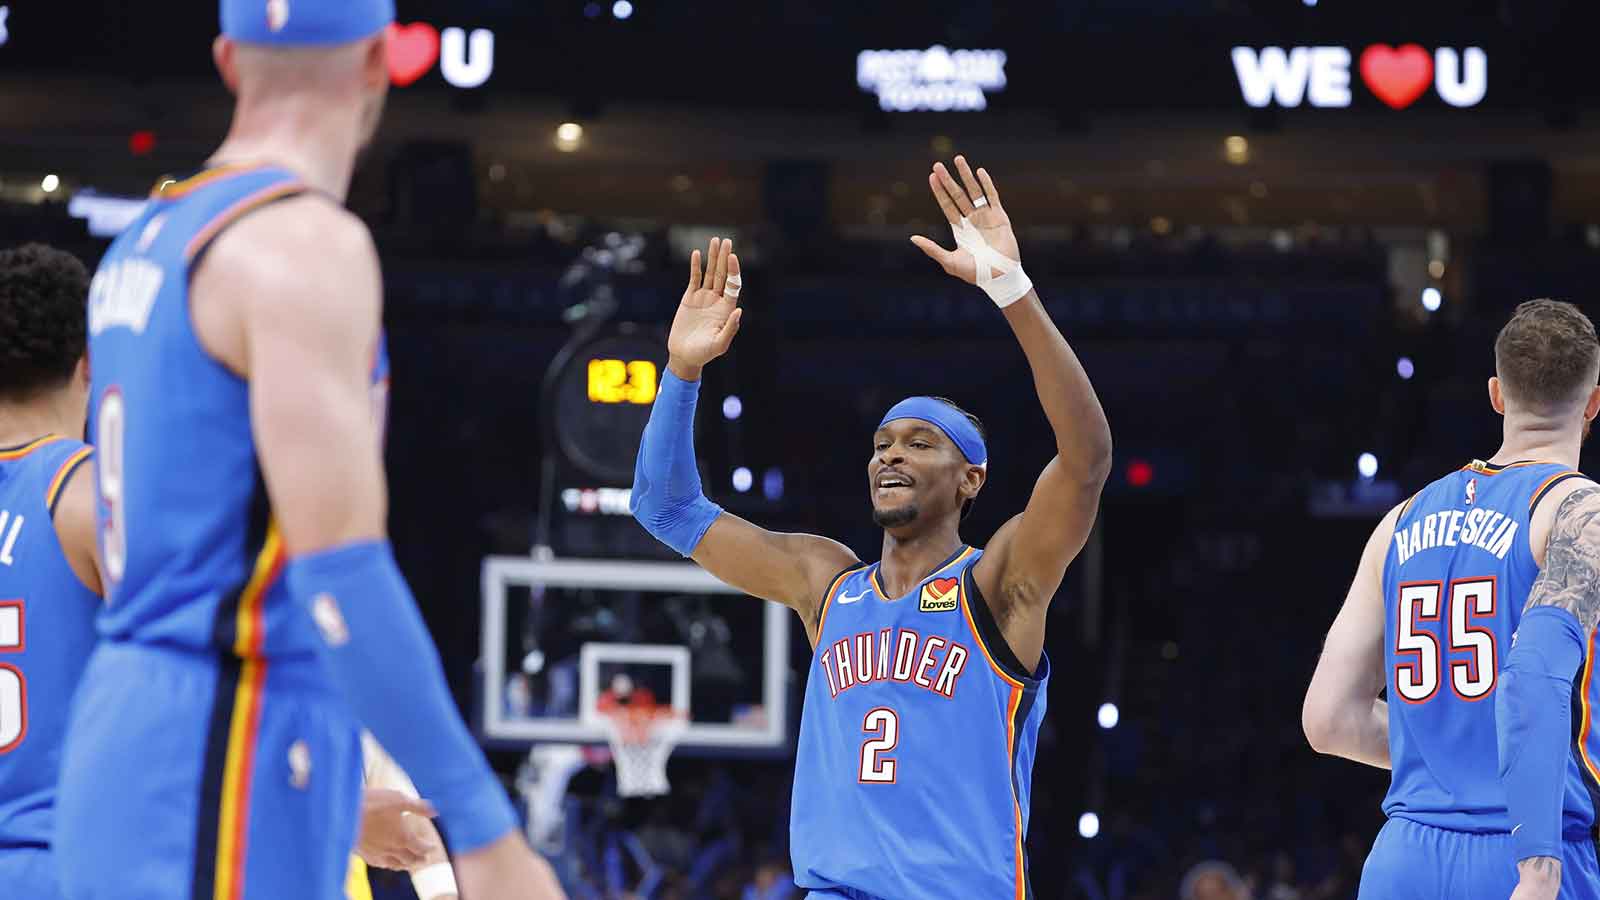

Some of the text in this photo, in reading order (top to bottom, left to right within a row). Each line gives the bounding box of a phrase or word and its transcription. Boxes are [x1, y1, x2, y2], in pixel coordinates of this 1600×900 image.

[440, 28, 494, 88] U
[1231, 46, 1488, 107] WE U
[1394, 507, 1519, 566] HARTESTEIN
[921, 597, 956, 609] Love's
[820, 627, 970, 700] THUNDER
[1394, 576, 1497, 705] 55
[857, 706, 900, 784] 2
